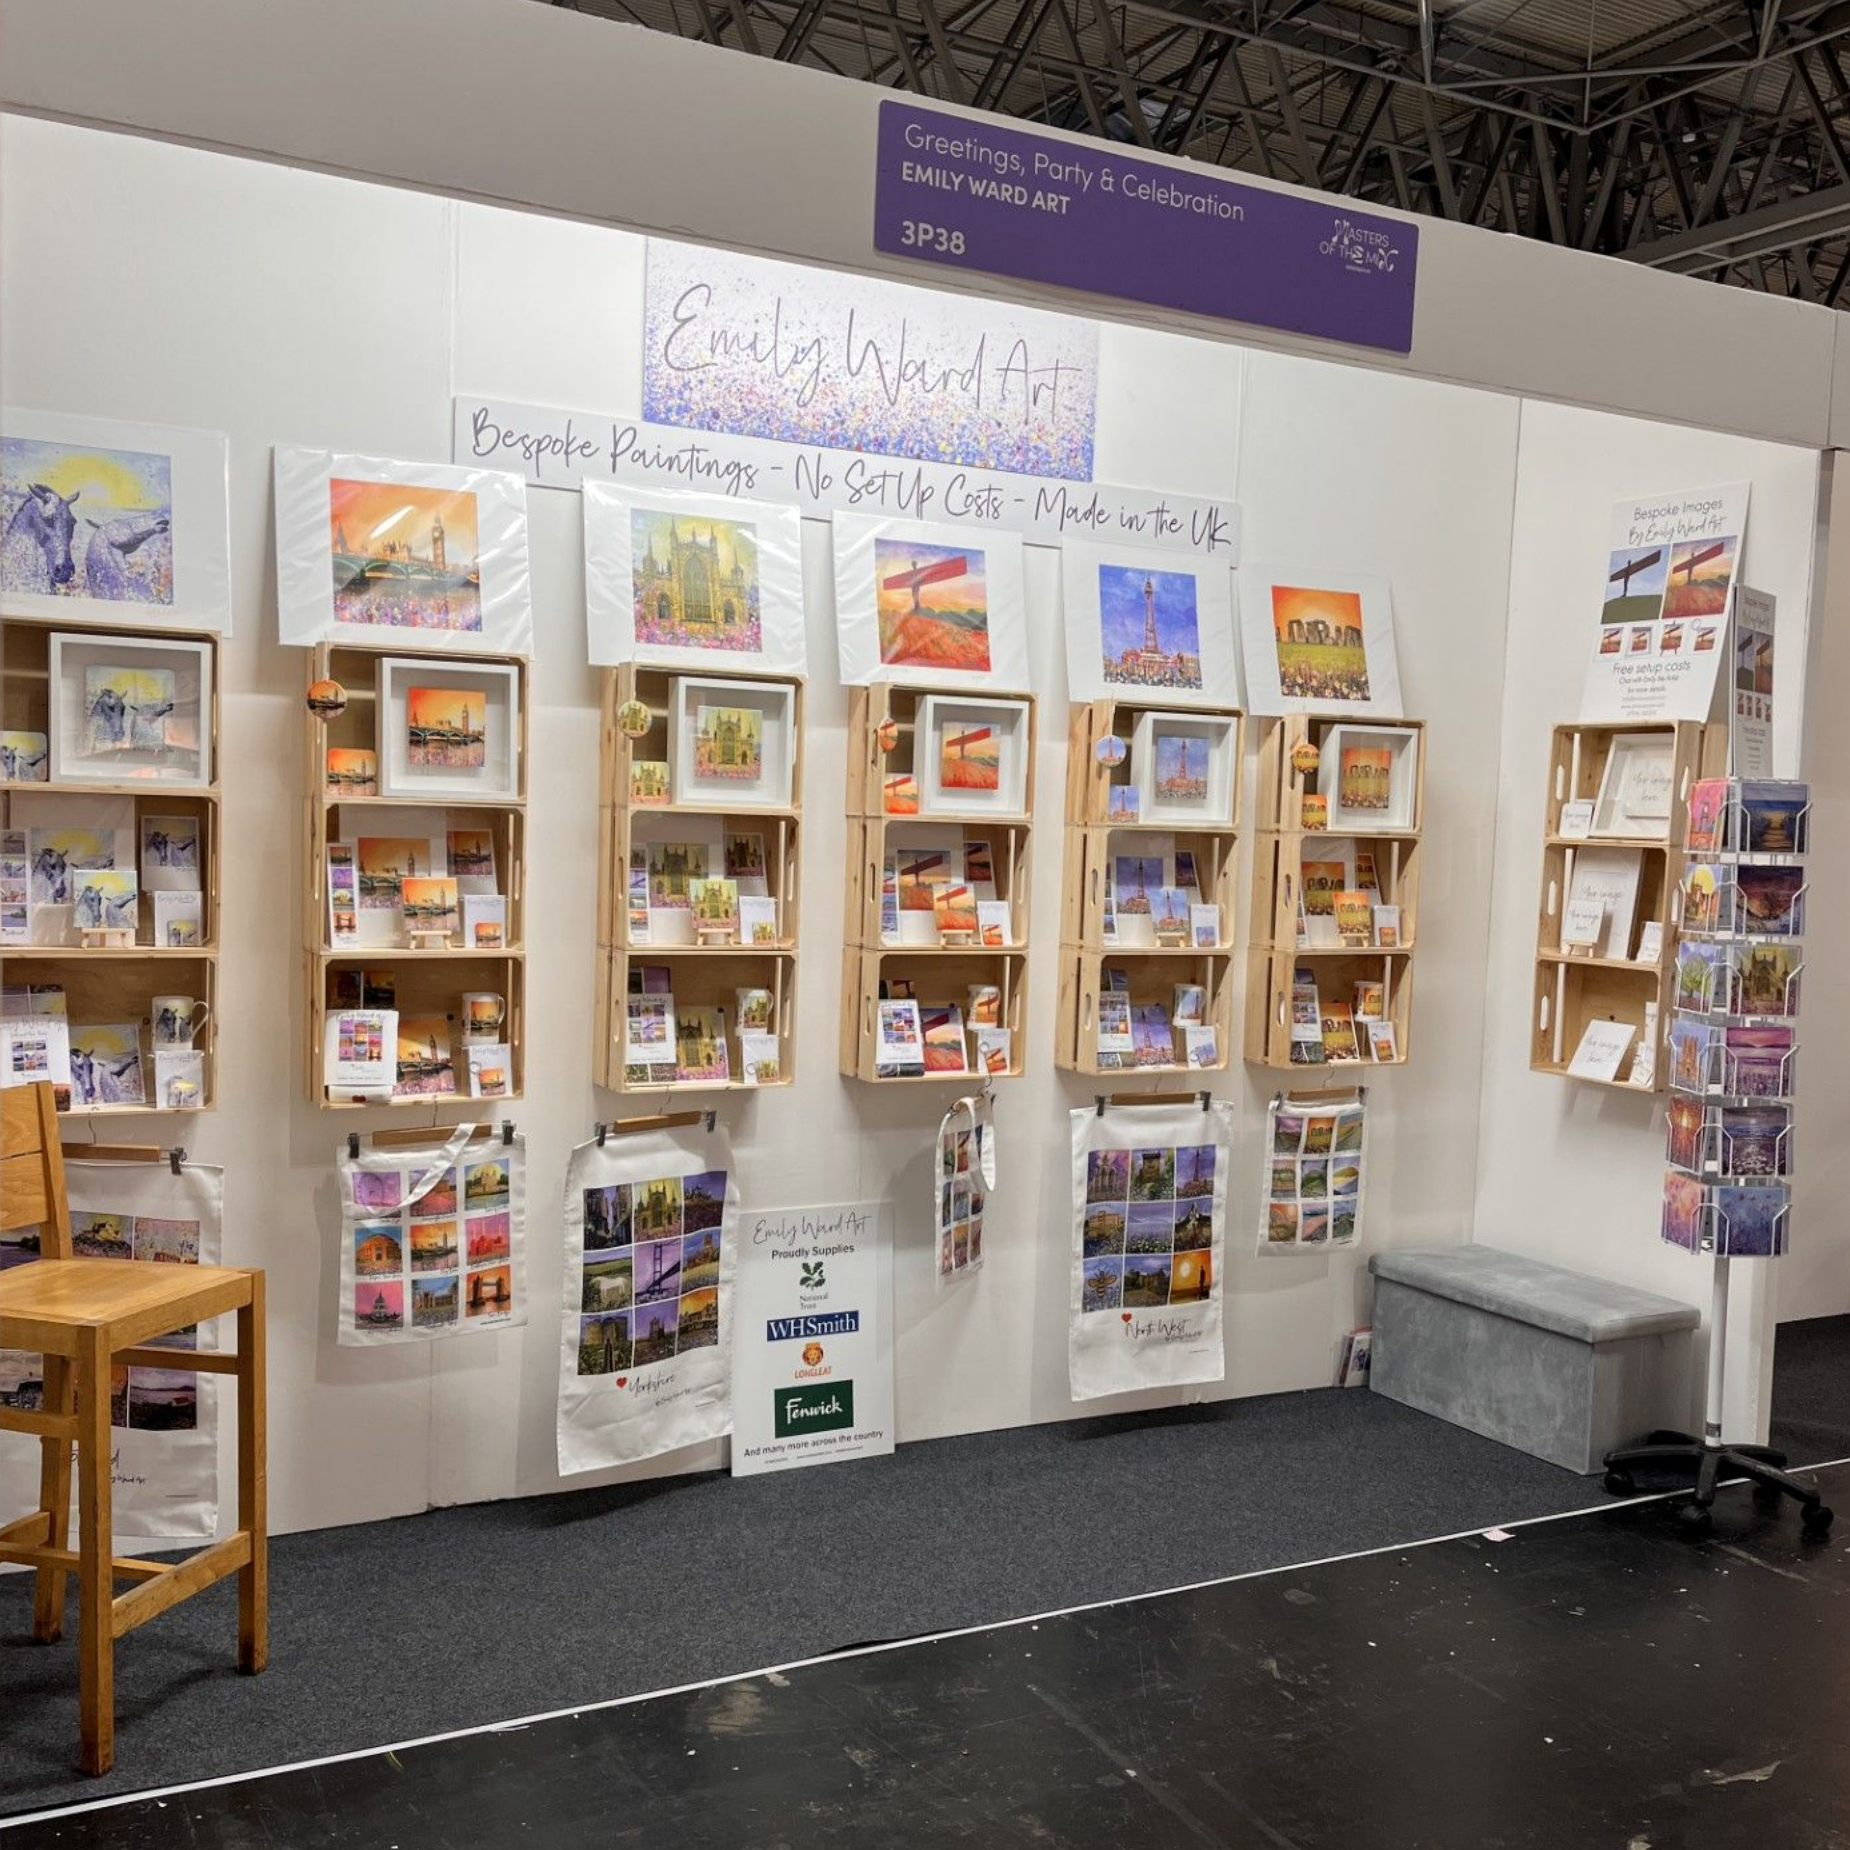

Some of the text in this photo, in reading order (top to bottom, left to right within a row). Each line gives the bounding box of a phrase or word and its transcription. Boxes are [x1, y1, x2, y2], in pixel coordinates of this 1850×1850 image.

[905, 124, 1244, 222] Greetings, Party & Celebration
[902, 161, 1070, 214] EMILY WARD ART
[901, 220, 965, 255] 3P38
[1319, 241, 1336, 255] OF
[664, 283, 1083, 425] Emily Ward Art
[472, 407, 600, 478] Bespoke
[609, 424, 760, 496] Paintings
[795, 453, 832, 501] No
[844, 459, 897, 504] Set
[897, 467, 934, 519] Up
[945, 473, 1004, 521] Costs
[1035, 487, 1111, 532] Made
[1119, 507, 1146, 532] in
[1147, 502, 1184, 537] the
[1634, 500, 1723, 521] Bespoke Images
[1628, 514, 1727, 546] By Emily Ward Art
[1613, 661, 1691, 675] Free setup costs
[753, 1211, 872, 1246] Emily Ward Art
[772, 1244, 855, 1259] Proudly Supplies
[769, 1313, 857, 1339] WHSmith
[1157, 1317, 1192, 1336] West
[628, 1371, 676, 1398] Yorkshire
[795, 1366, 832, 1379] LONGLEAT
[785, 1395, 843, 1425] Fenwick
[744, 1448, 761, 1457] And
[762, 1445, 785, 1455] many
[787, 1441, 809, 1449] more
[811, 1438, 837, 1447] across
[838, 1434, 852, 1443] the
[854, 1430, 884, 1441] country
